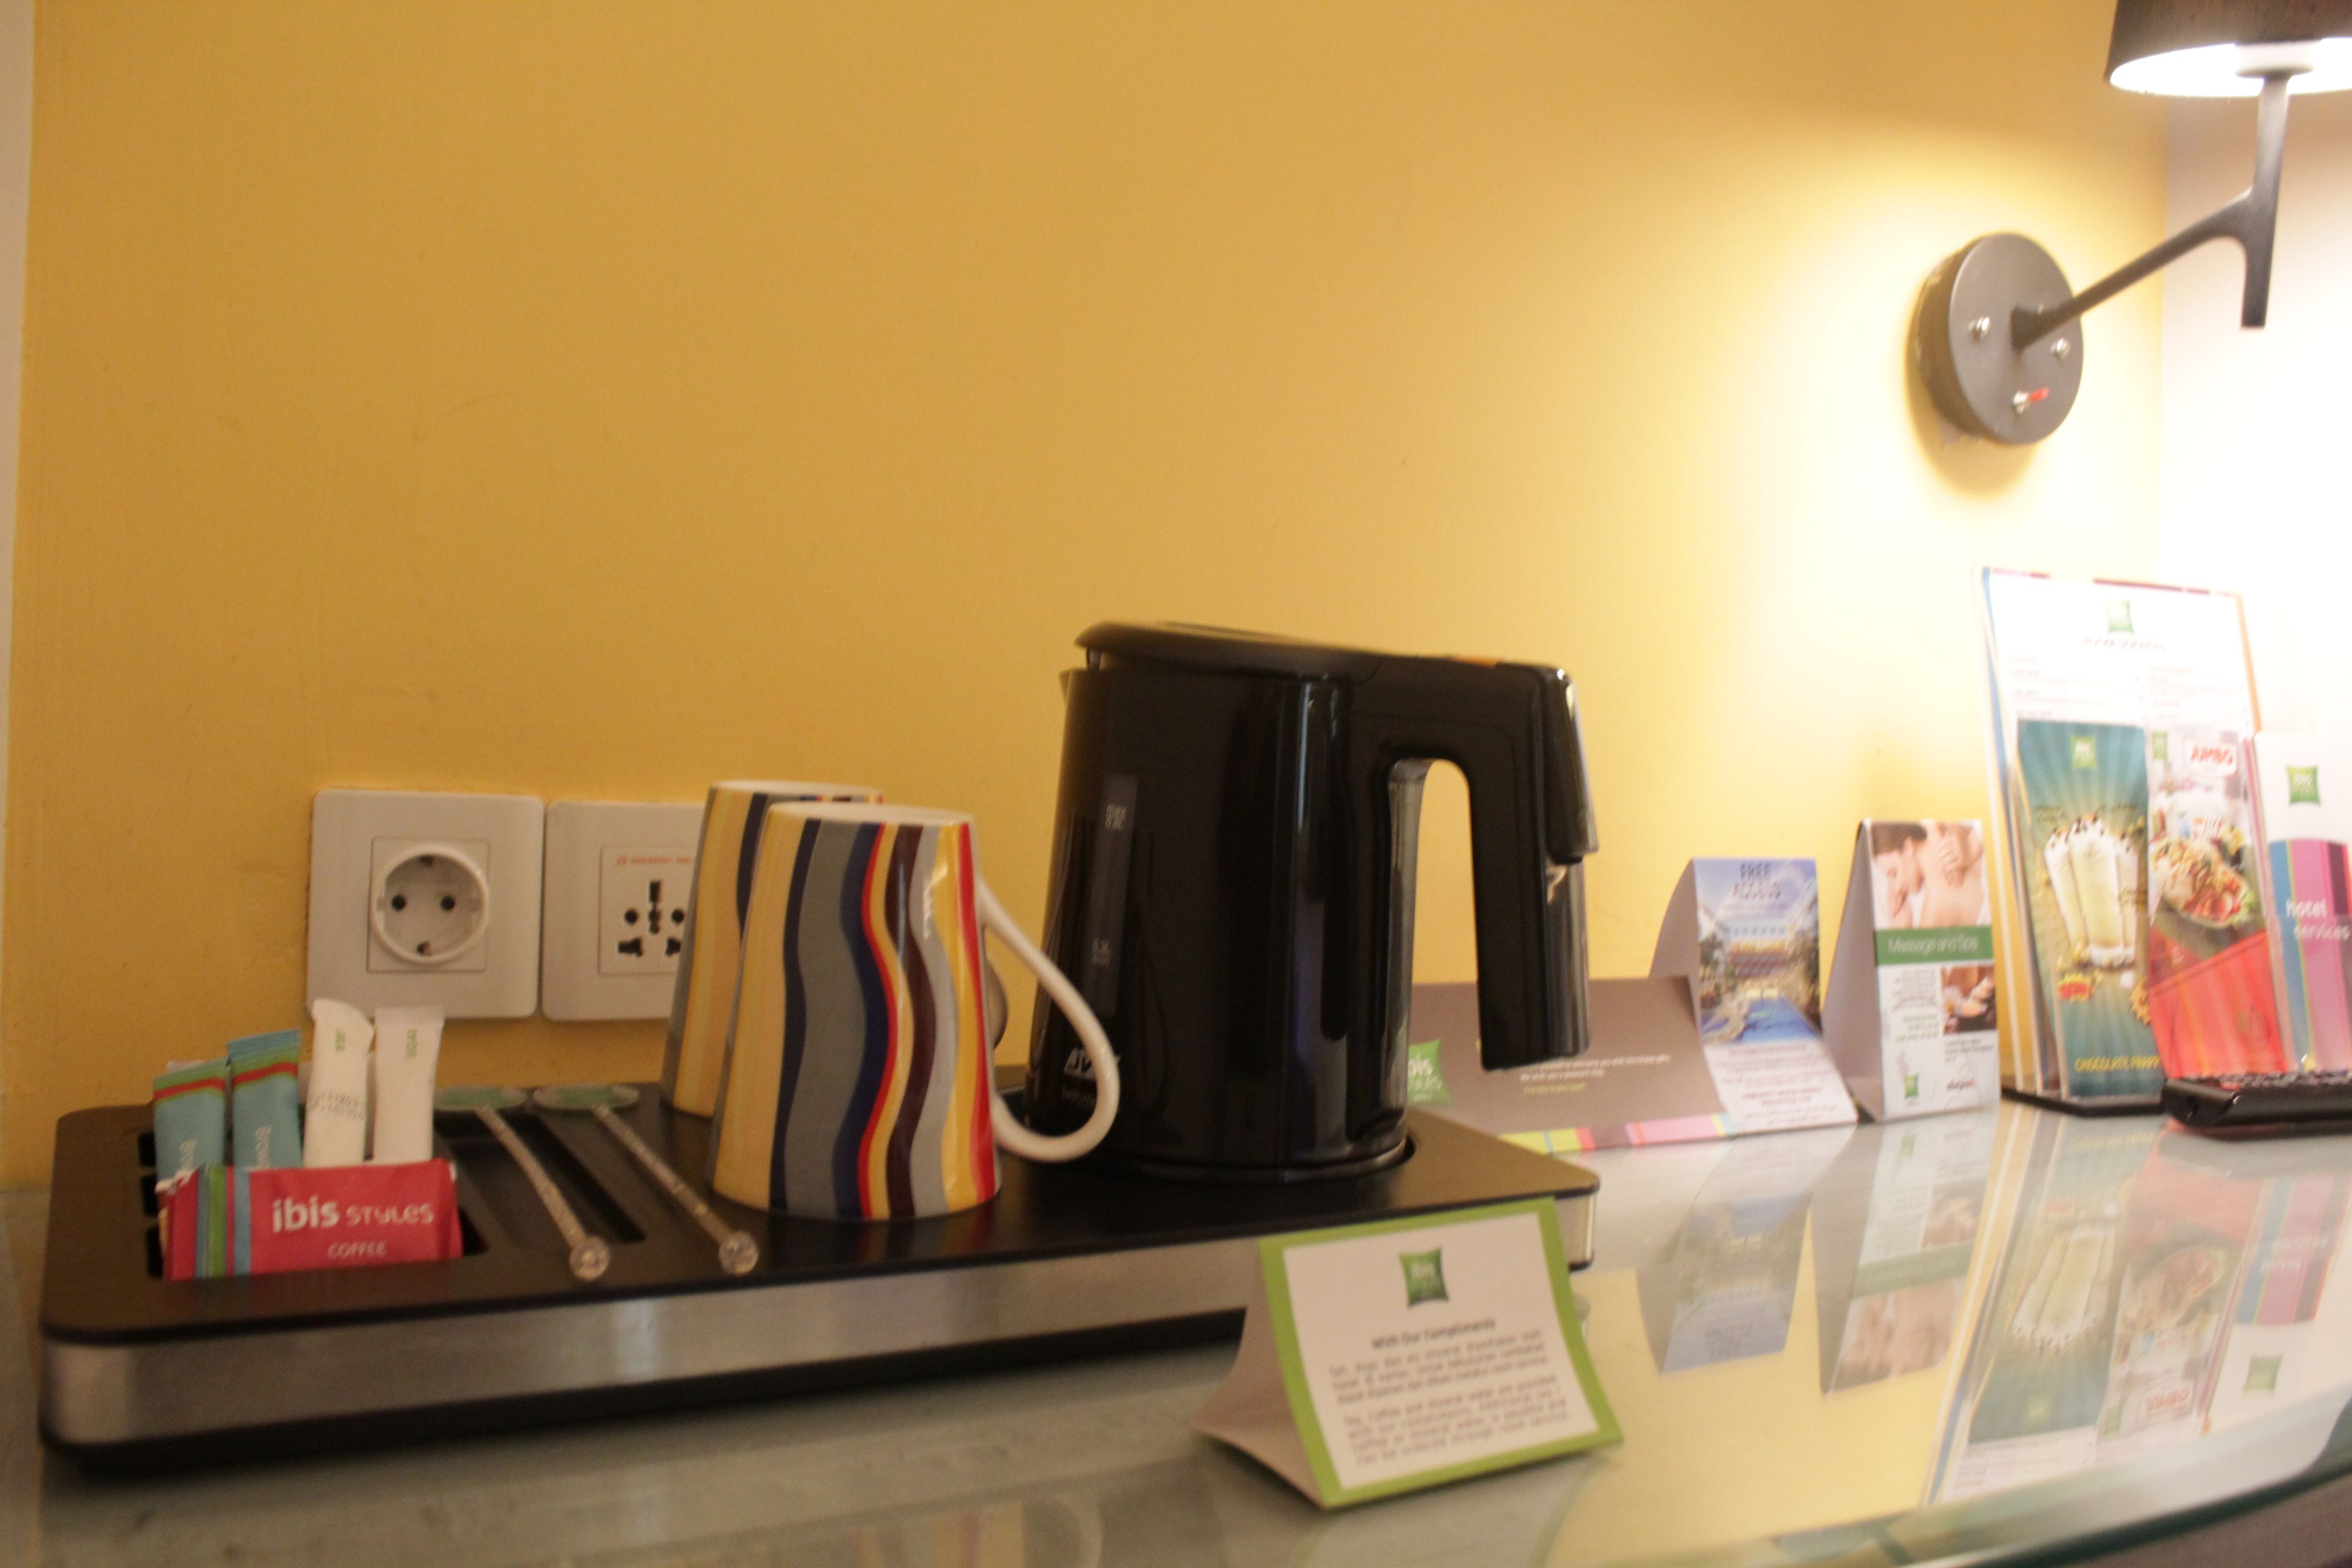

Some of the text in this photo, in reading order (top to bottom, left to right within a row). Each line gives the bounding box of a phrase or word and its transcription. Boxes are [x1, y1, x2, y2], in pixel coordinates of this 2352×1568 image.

[2285, 897, 2327, 918] hotel
[2293, 922, 2351, 941] services
[273, 1195, 340, 1233] ibis
[327, 1240, 388, 1259] COFFEE
